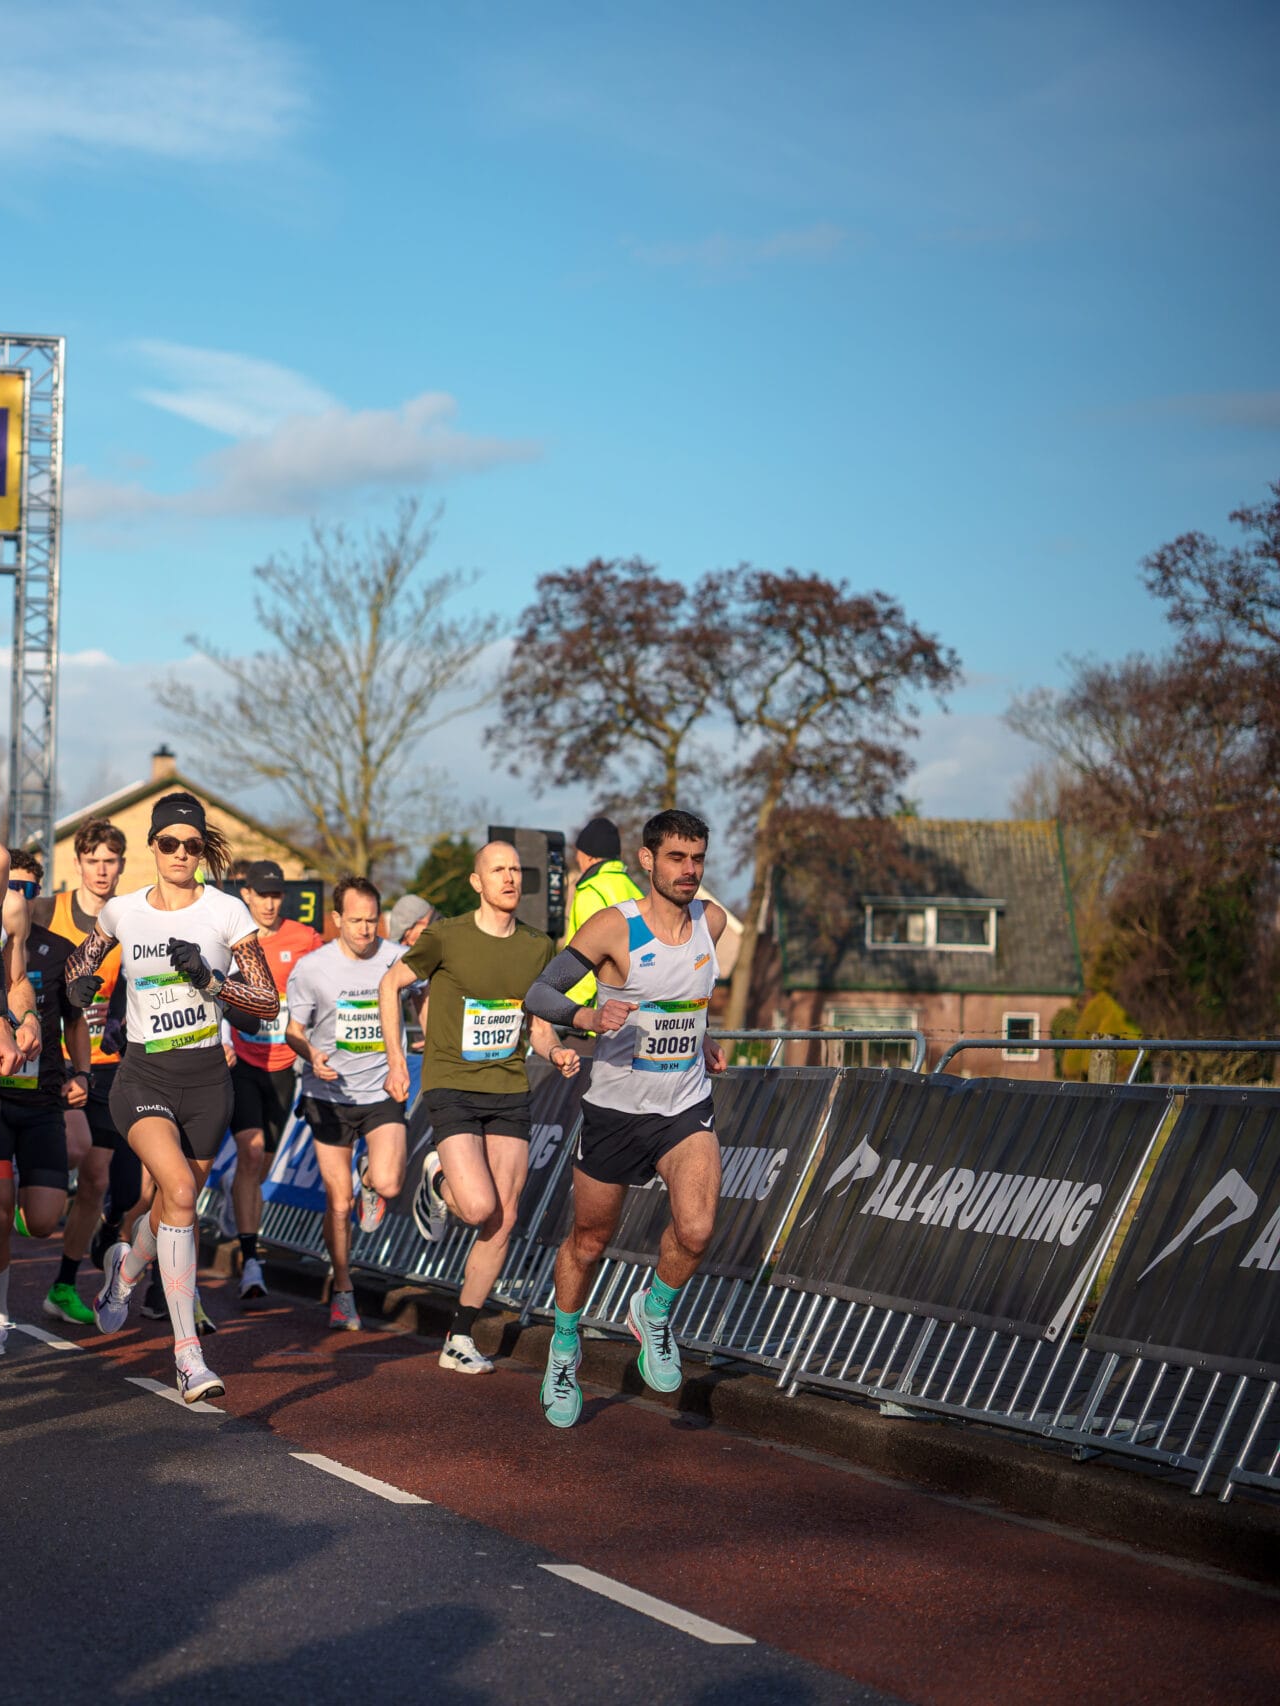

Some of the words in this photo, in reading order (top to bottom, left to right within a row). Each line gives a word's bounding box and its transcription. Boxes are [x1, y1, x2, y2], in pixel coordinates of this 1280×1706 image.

[150, 1004, 207, 1034] 20004
[474, 1015, 486, 1025] DE
[488, 1014, 516, 1025] GROOT
[655, 1017, 696, 1031] VROLIJK
[473, 1029, 514, 1046] 30187
[646, 1035, 697, 1055] 30081
[859, 1159, 1102, 1246] ALL4RUNNING
